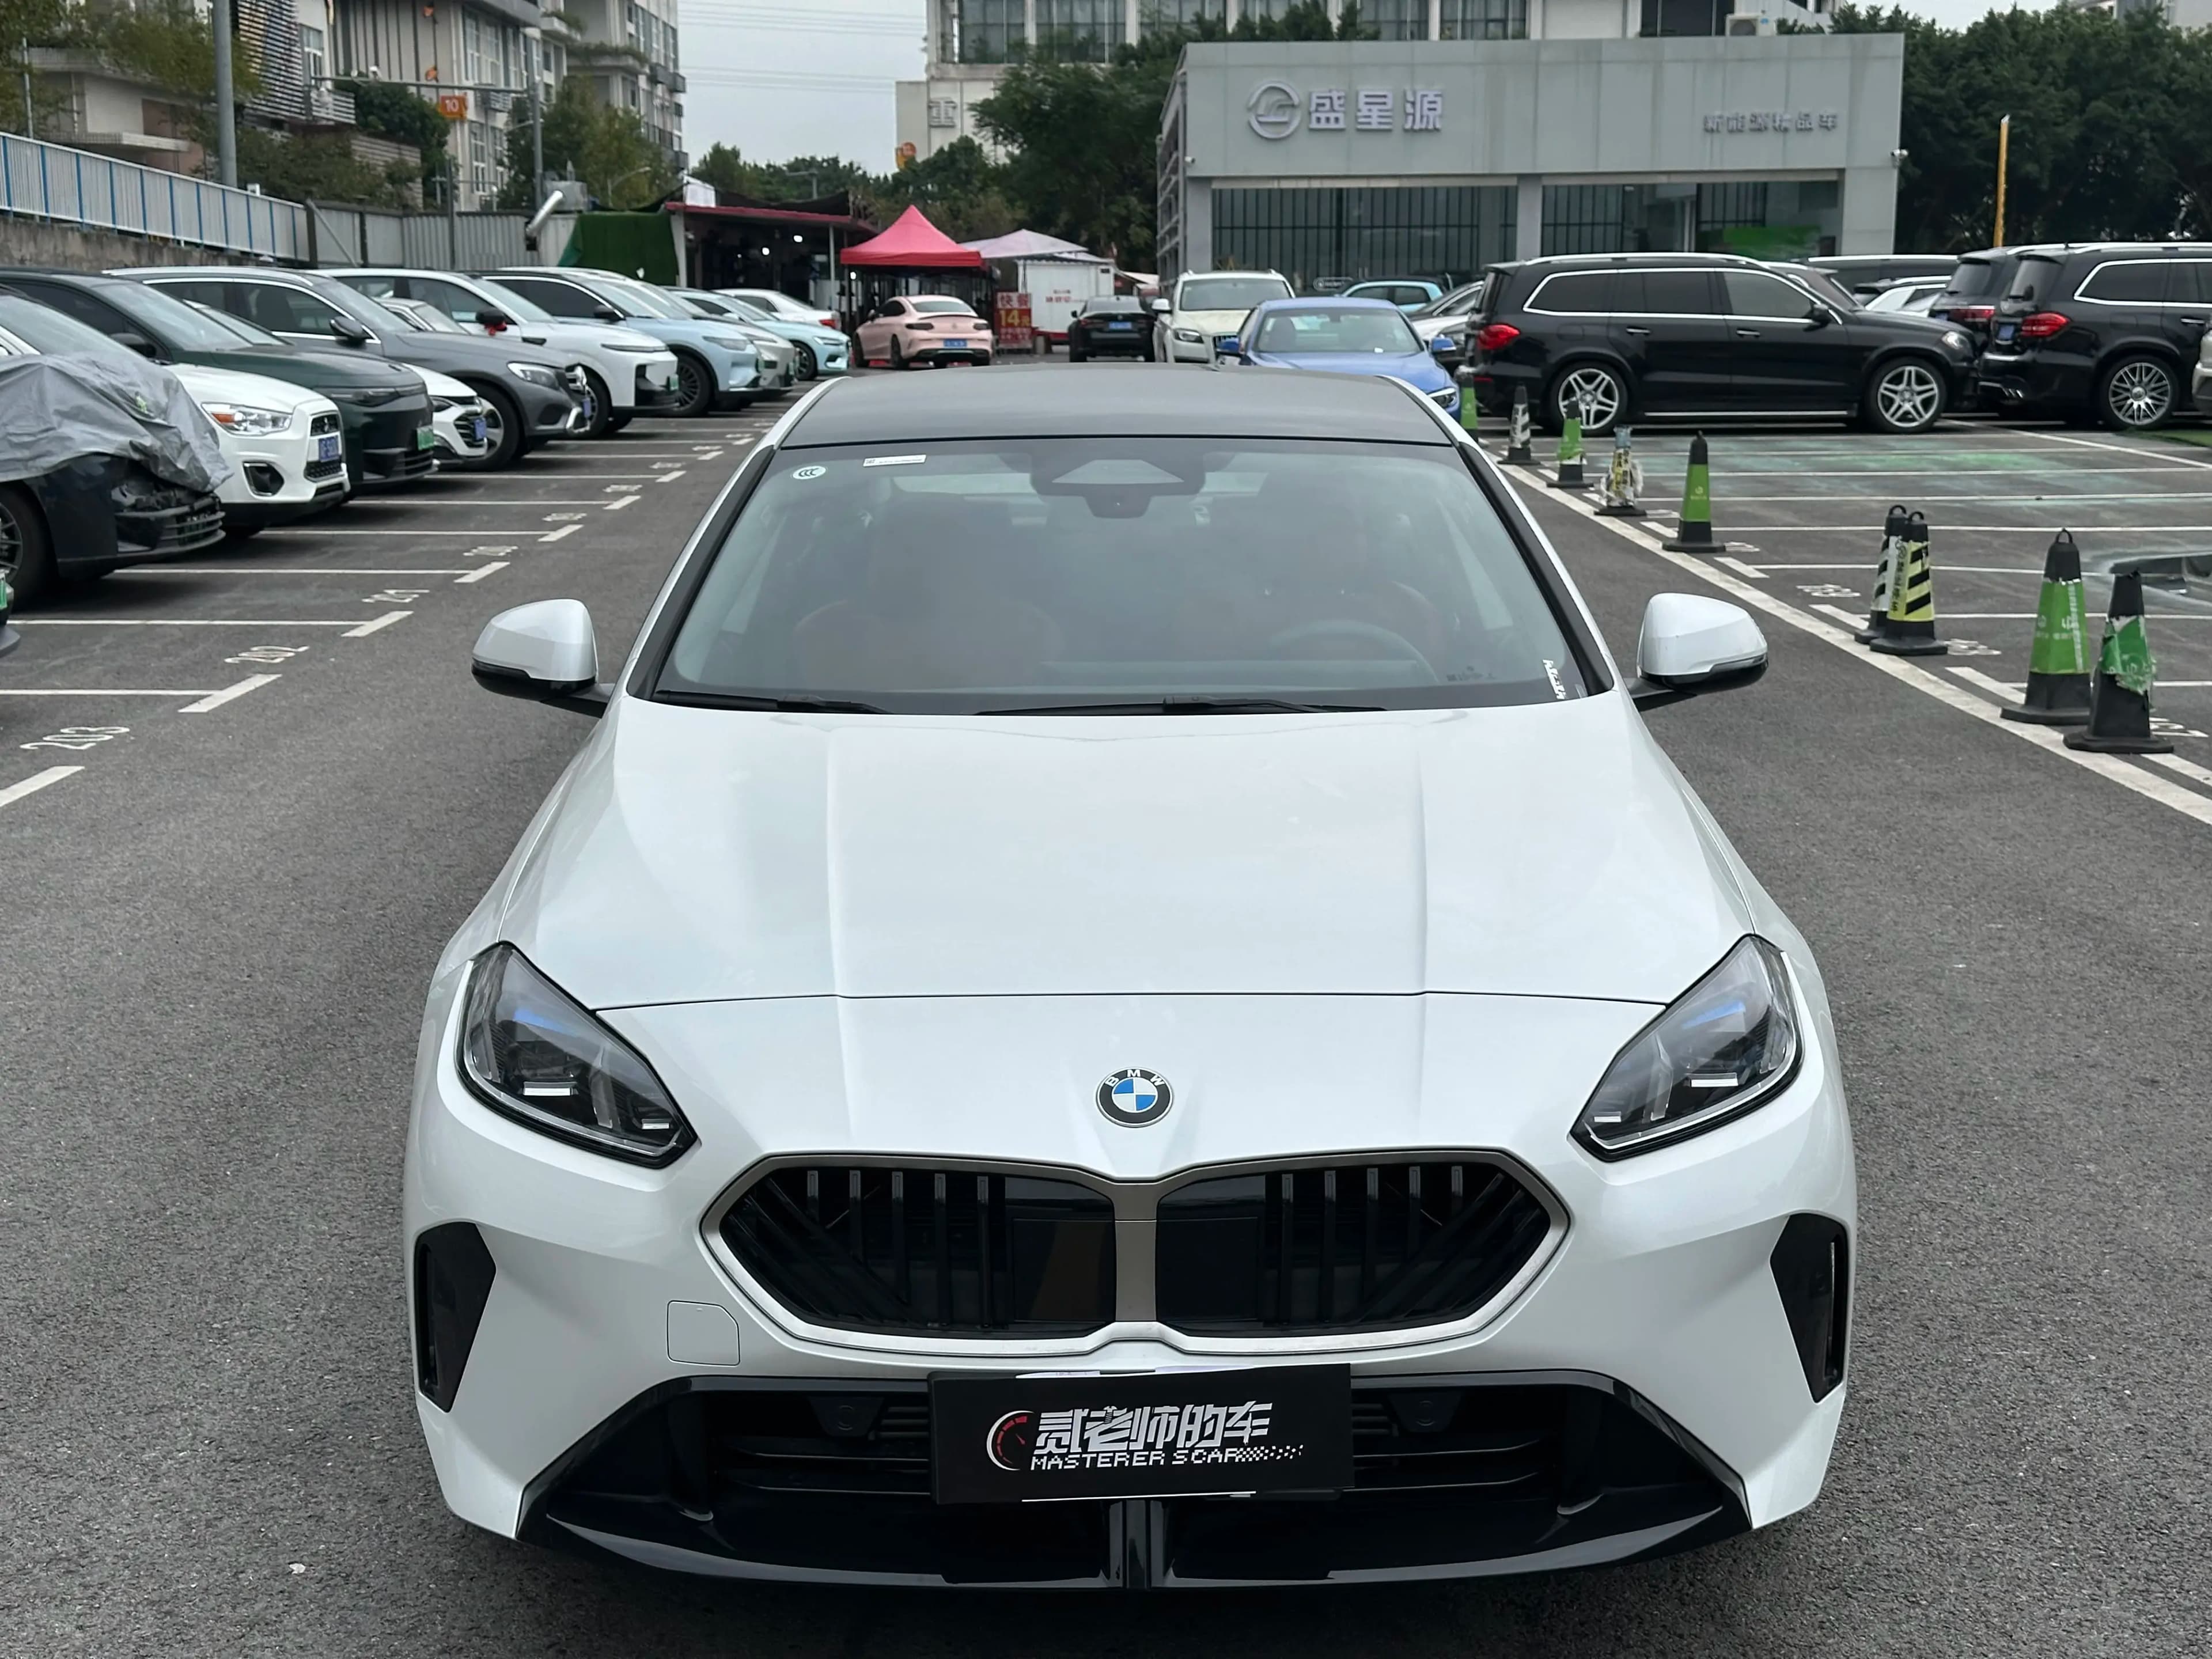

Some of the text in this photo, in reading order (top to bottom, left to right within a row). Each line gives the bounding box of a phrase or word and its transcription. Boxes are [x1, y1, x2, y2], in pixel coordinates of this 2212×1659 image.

[445, 99, 459, 112] 10
[1308, 89, 1442, 131] 盛星源
[1703, 112, 1838, 133] 新能源精品车
[362, 589, 430, 603] 201
[224, 645, 309, 665] 202
[20, 726, 130, 750] 203
[1105, 1069, 1165, 1087] BMW
